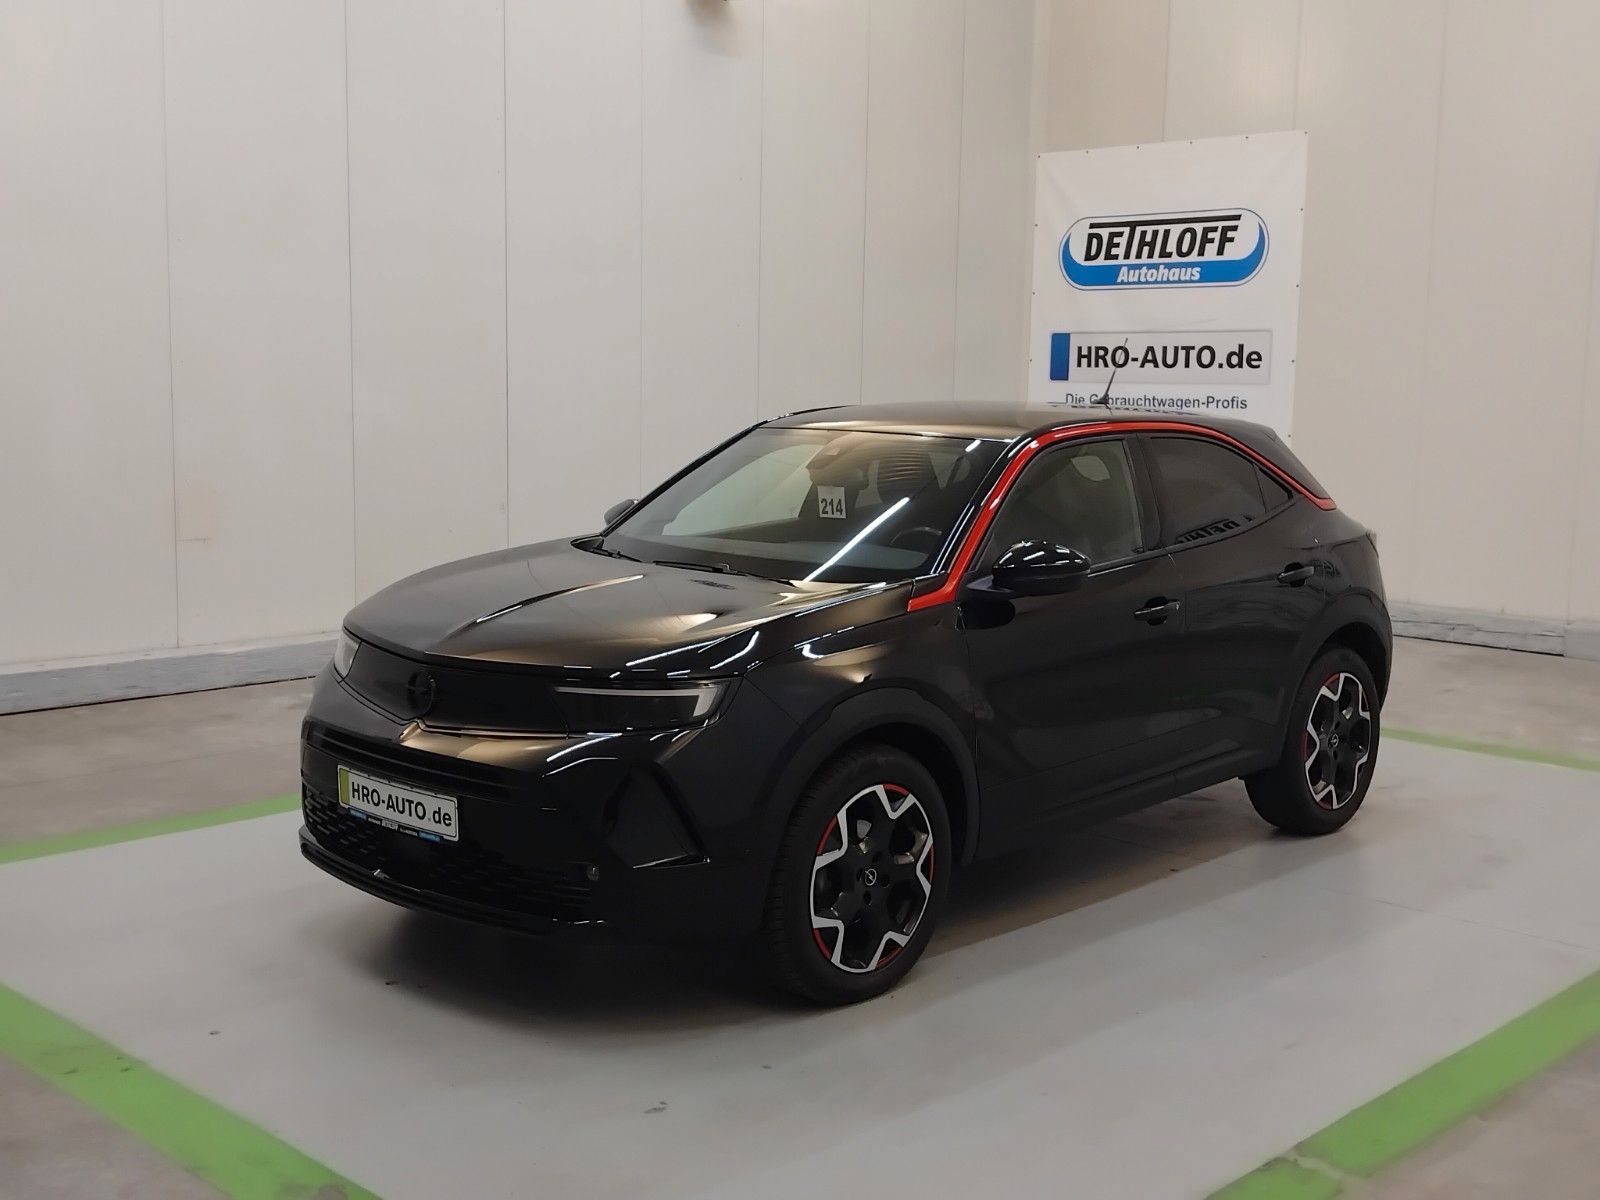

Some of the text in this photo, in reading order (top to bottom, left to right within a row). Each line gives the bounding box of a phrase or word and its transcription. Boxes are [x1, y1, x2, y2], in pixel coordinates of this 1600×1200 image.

[1084, 214, 1242, 262] DETHLOFF
[1117, 265, 1202, 283] Autohaus
[1076, 343, 1263, 369] HRO-AUTO.de
[1065, 393, 1248, 410] Die Gbrauchtwagen-Profis
[820, 498, 843, 516] 214
